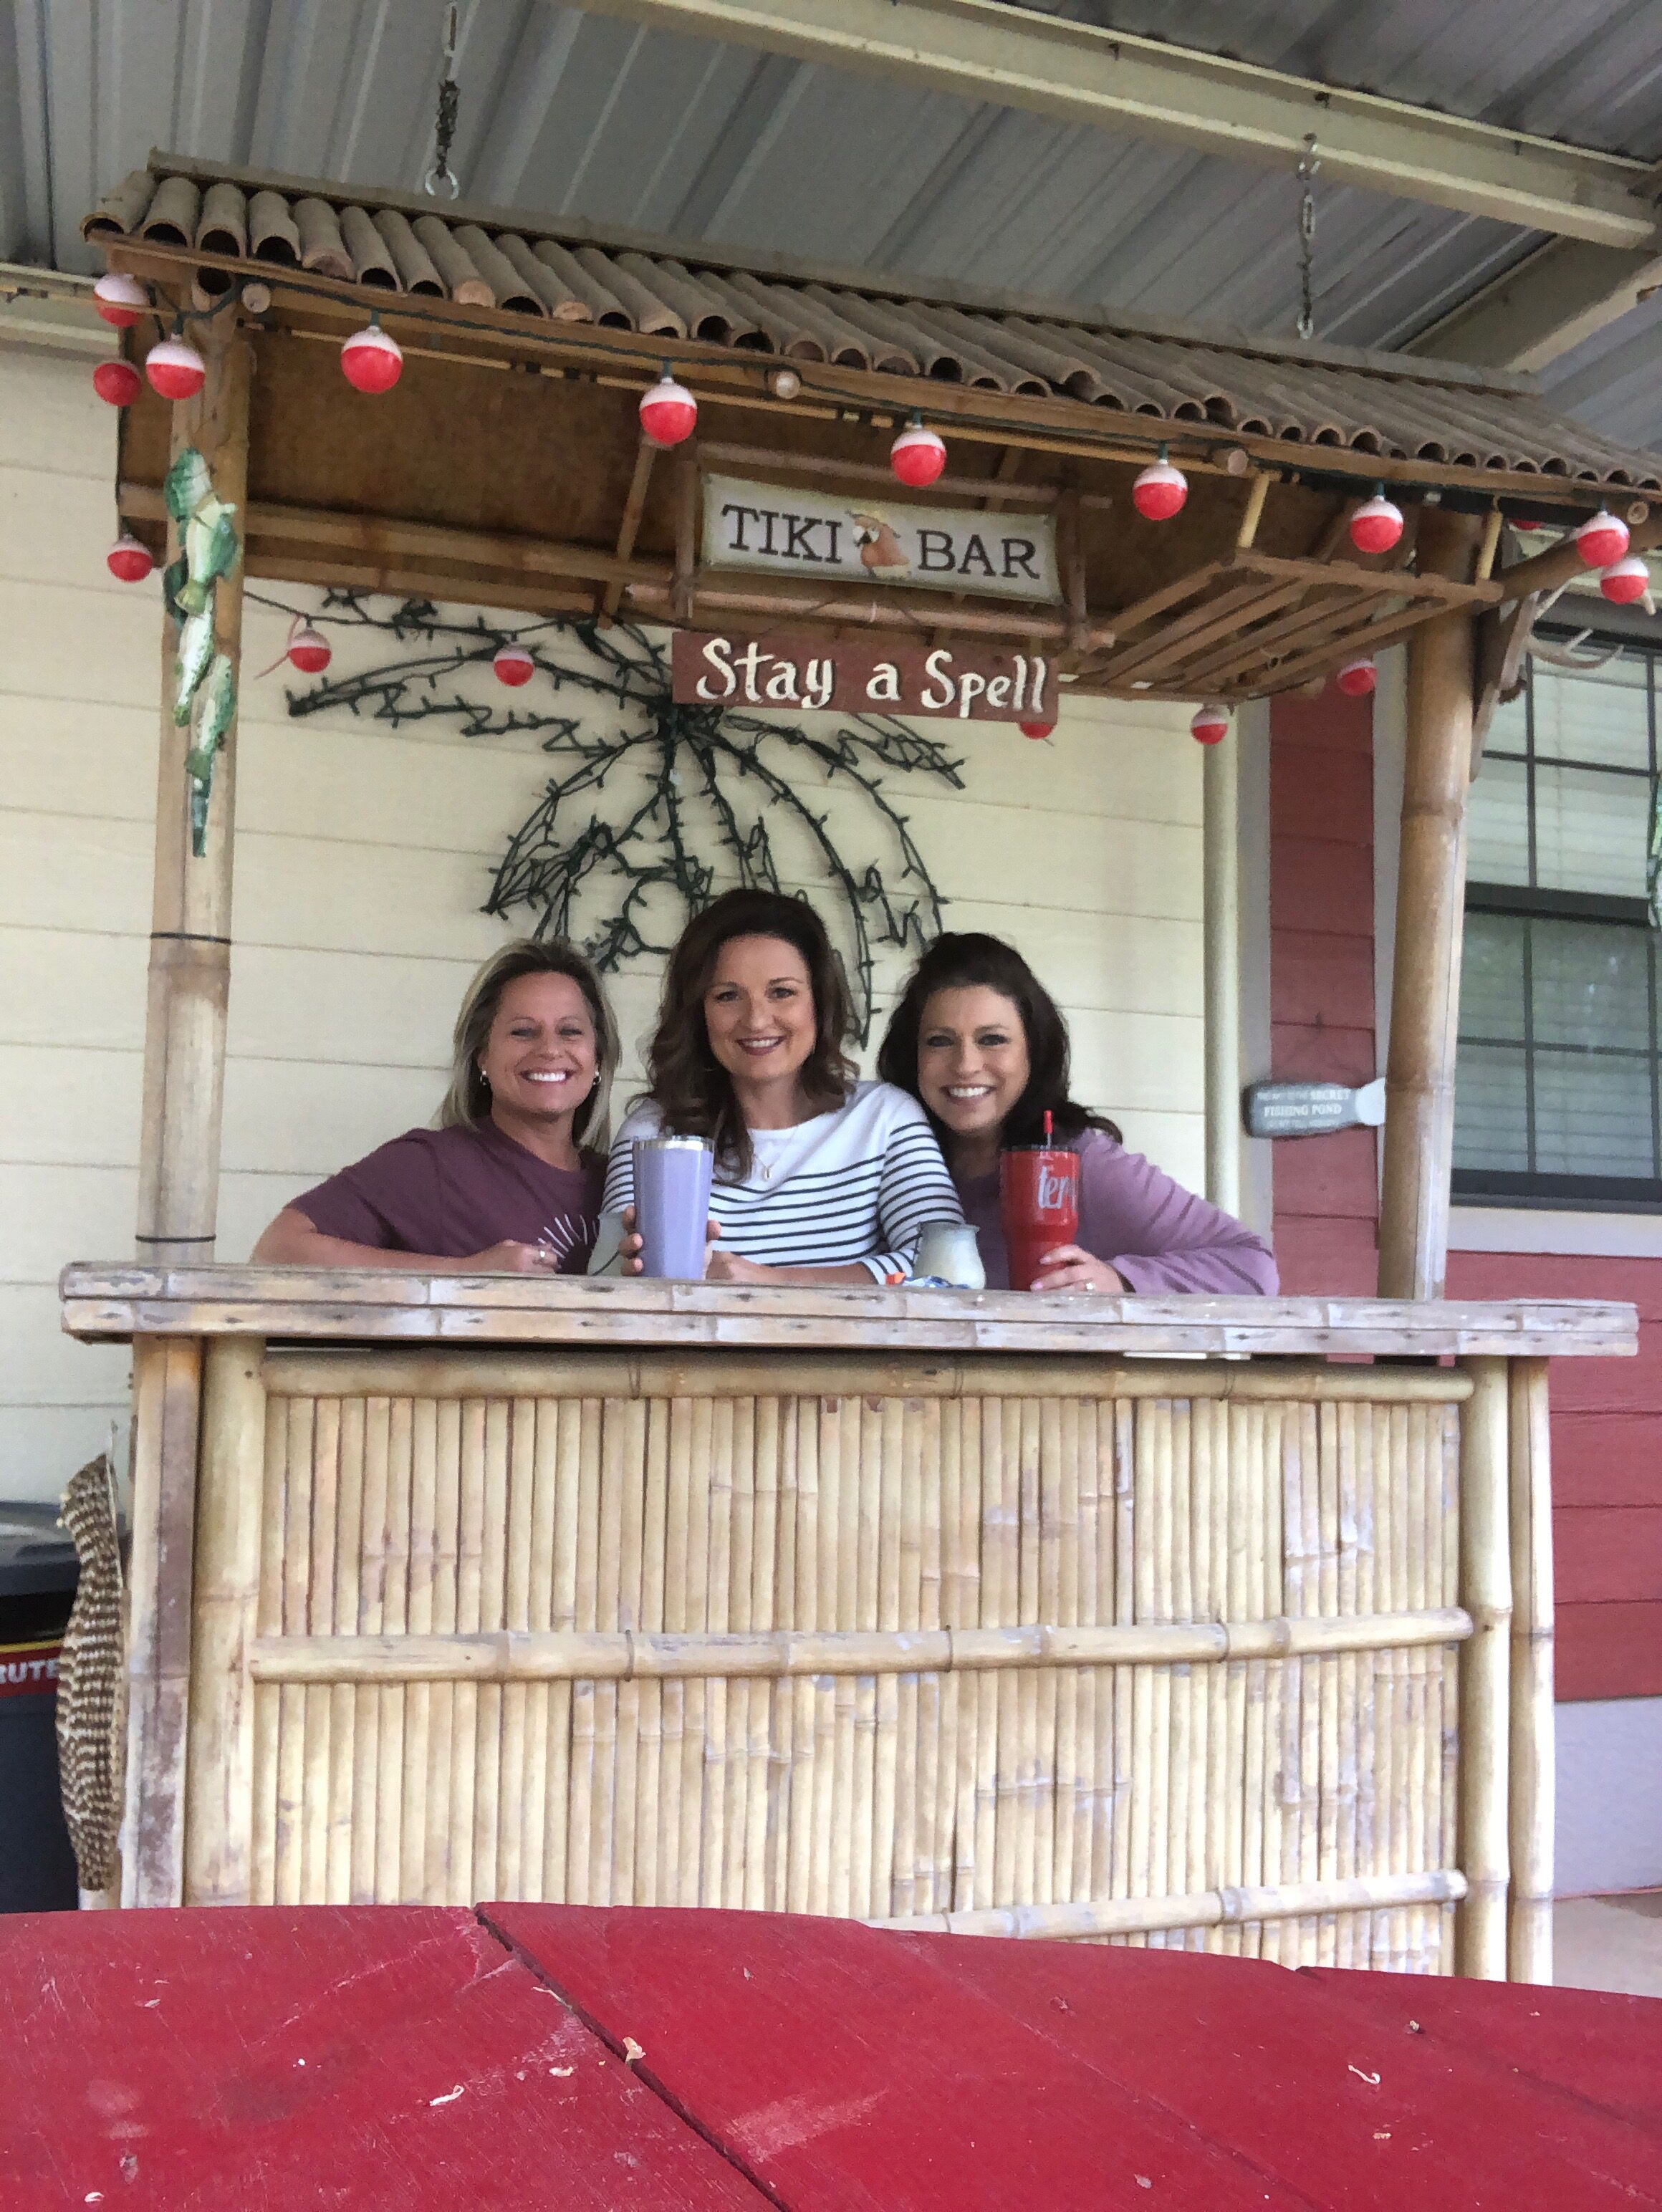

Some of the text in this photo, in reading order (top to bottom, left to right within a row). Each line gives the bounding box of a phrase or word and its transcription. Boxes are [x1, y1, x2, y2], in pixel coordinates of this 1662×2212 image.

[721, 503, 1041, 580] TIKI BAR
[696, 638, 1047, 718] Stay a Spell
[1264, 1103, 1342, 1117] FISHING POND
